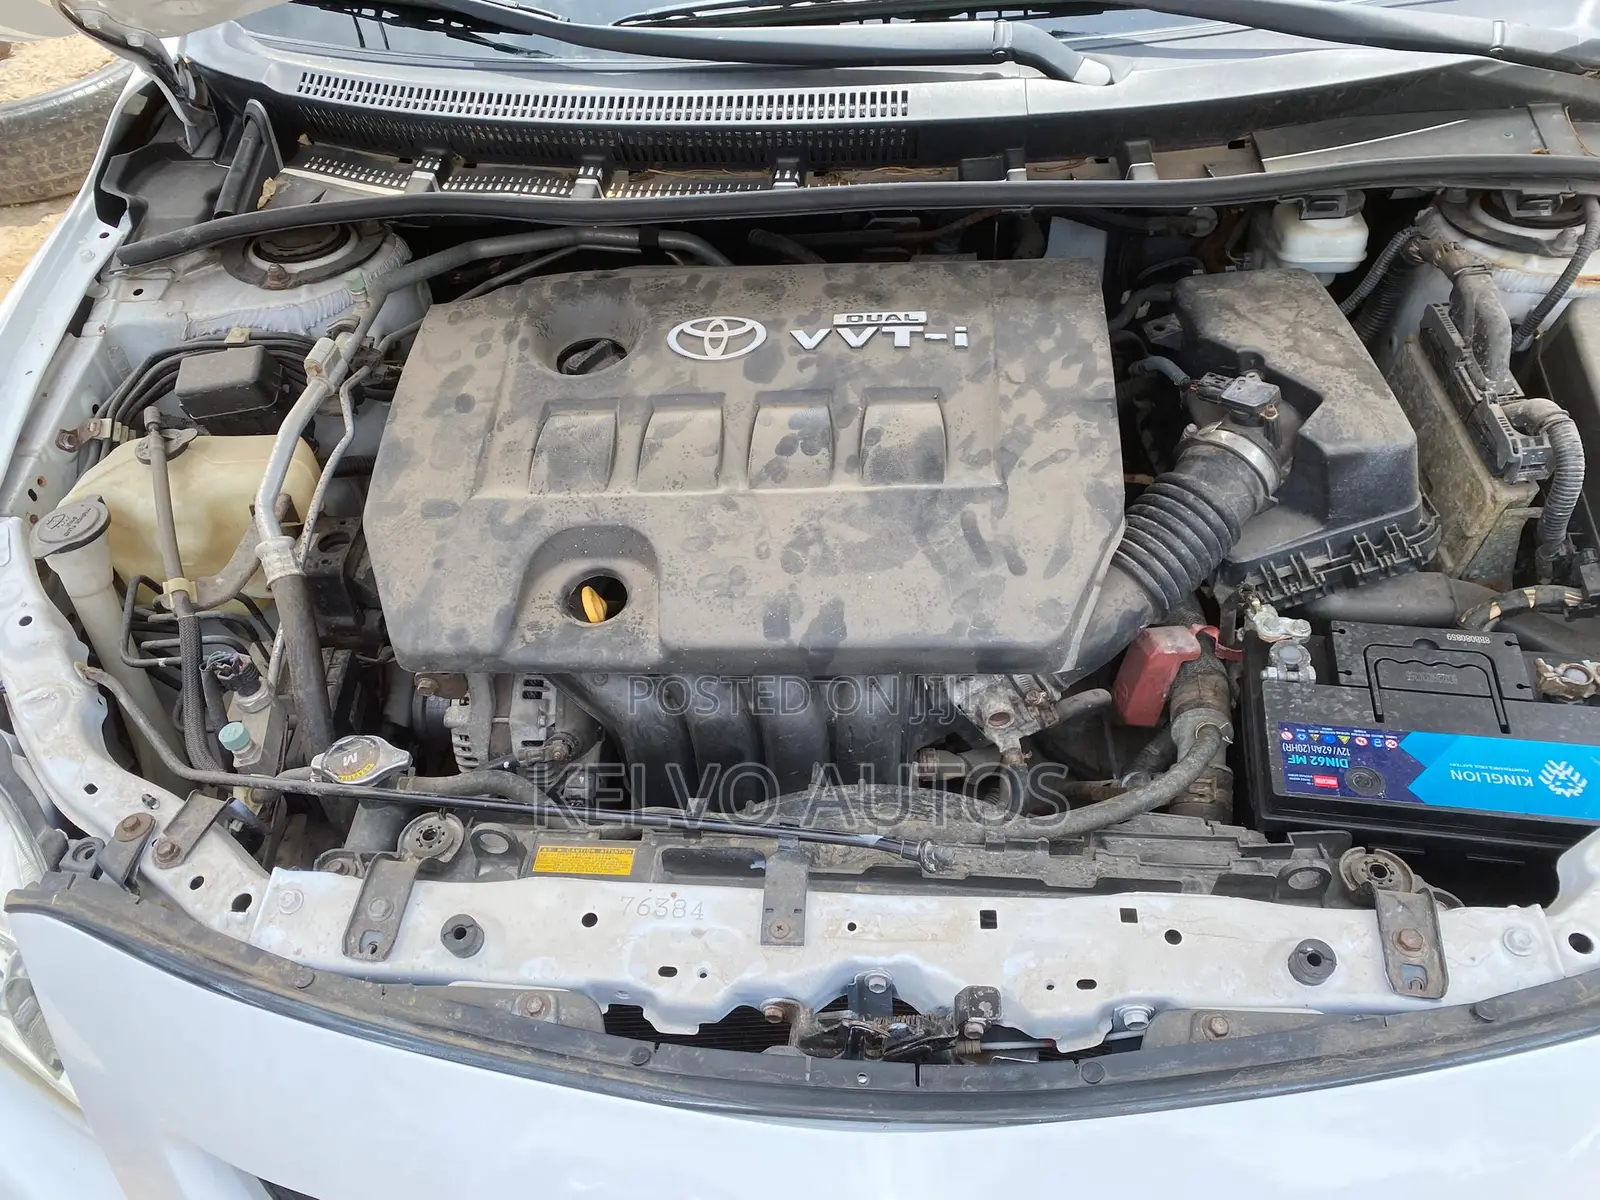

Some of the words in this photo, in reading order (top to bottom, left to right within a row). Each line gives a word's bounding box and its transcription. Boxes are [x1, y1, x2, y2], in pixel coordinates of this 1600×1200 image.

[846, 313, 919, 322] DUAL
[789, 325, 969, 350] VVT-i
[1287, 755, 1308, 766] MF
[1312, 756, 1349, 769] DIN62
[1449, 769, 1534, 787] KINGLION
[620, 896, 704, 920] 76384
